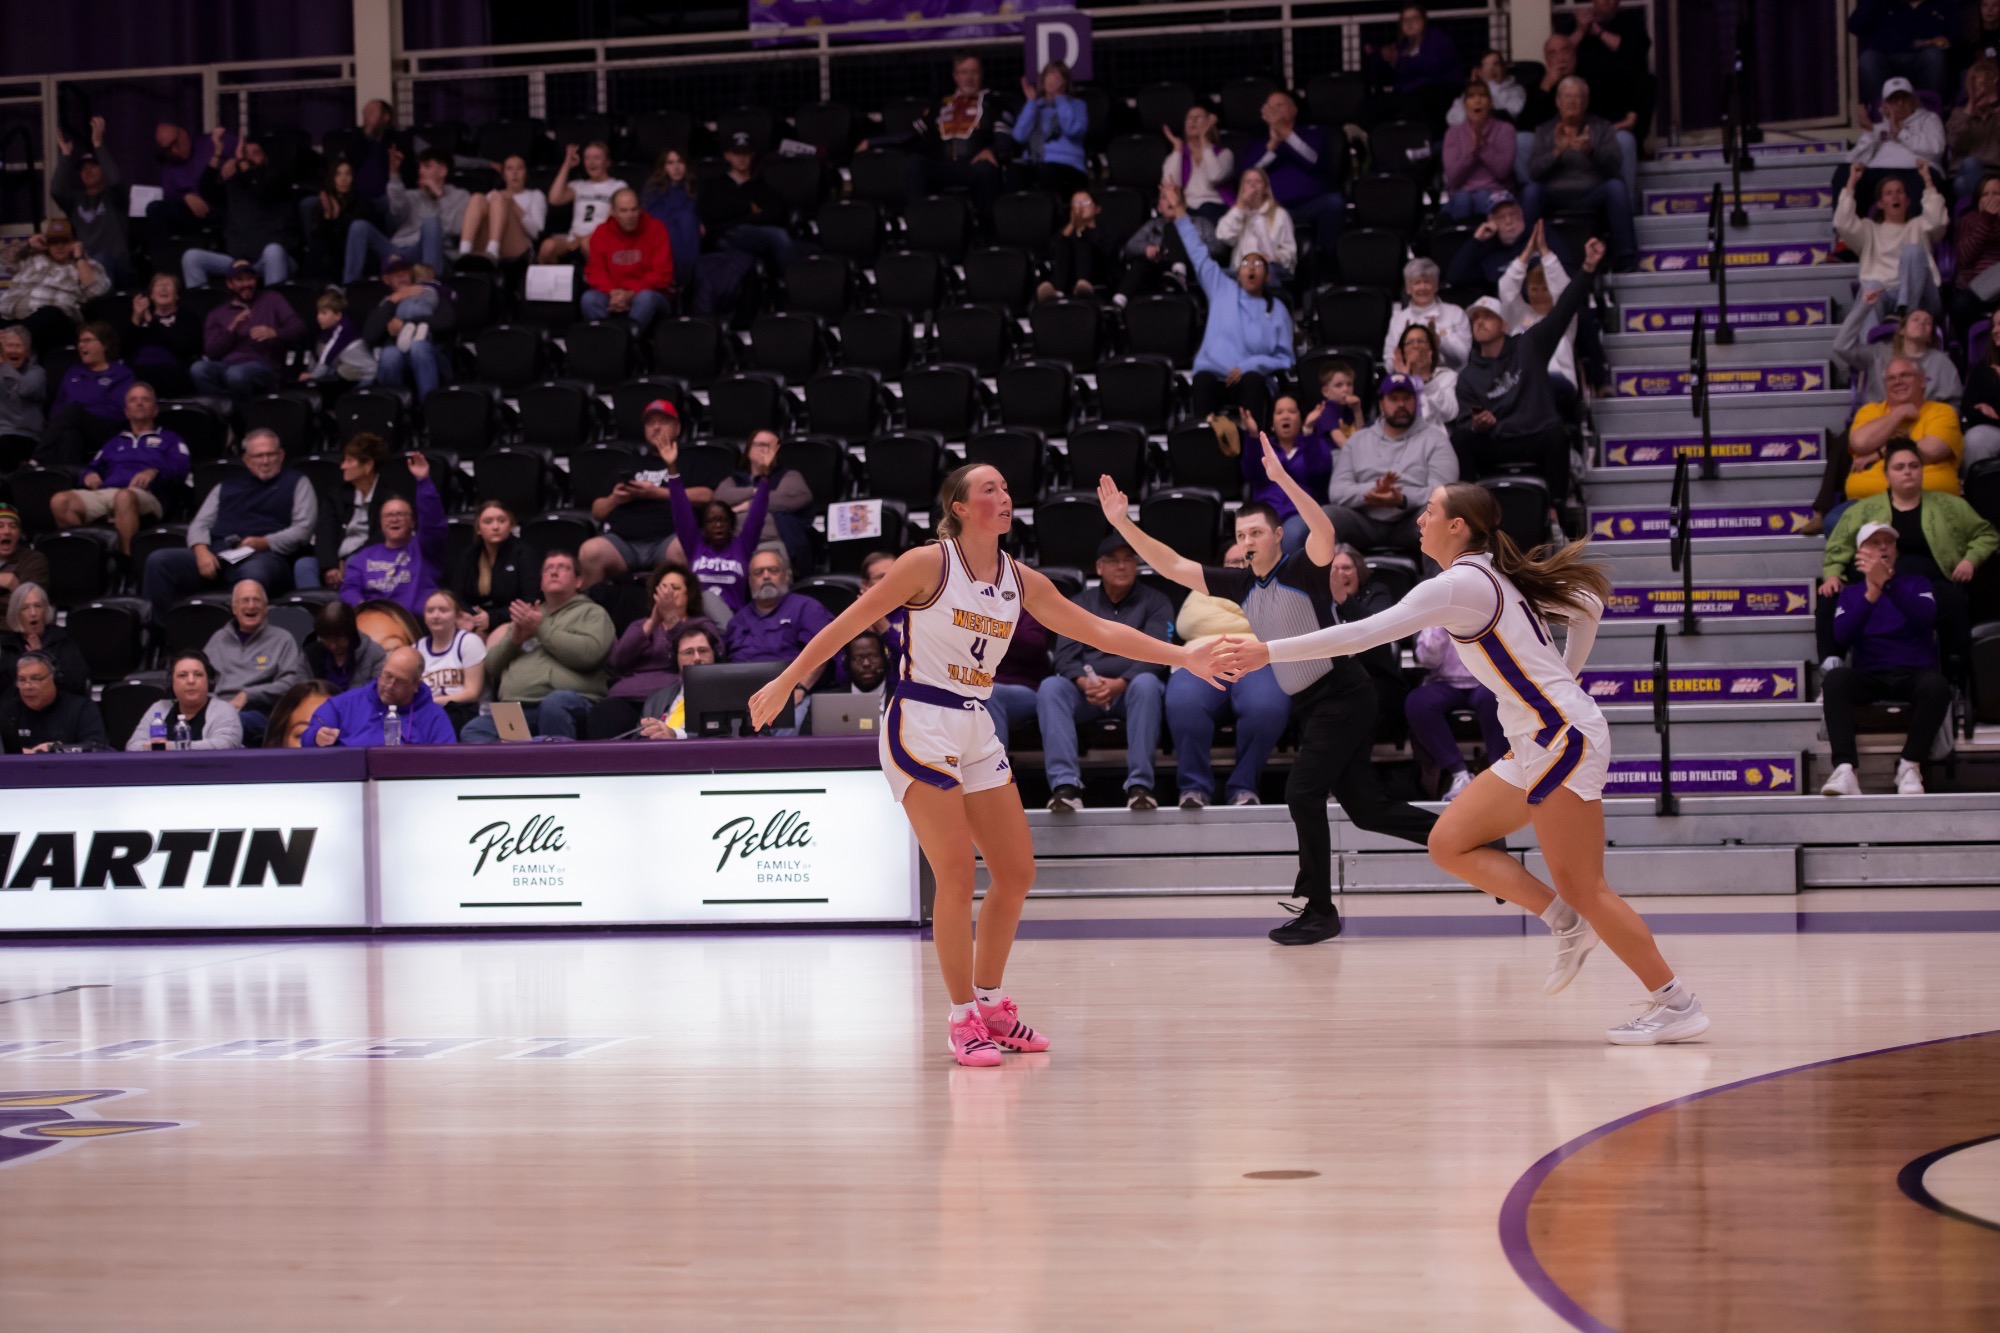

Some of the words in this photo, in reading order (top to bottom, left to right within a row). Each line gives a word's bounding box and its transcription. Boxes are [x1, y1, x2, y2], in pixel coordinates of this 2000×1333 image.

[1036, 22, 1079, 75] D
[1718, 516, 1762, 528] ATHLETICS
[970, 636, 988, 669] 4
[1633, 678, 1722, 693] LEAERNECKS
[1605, 771, 1647, 784] WESTERN
[1689, 769, 1738, 782] ATHLETICS
[469, 813, 567, 877] Pella
[712, 809, 813, 873] Pella
[0, 827, 319, 892] ARTIN
[757, 860, 801, 870] FAMILY
[512, 864, 555, 874] FAMILY
[513, 877, 564, 887] BRANDS
[757, 873, 810, 883] BRANDS
